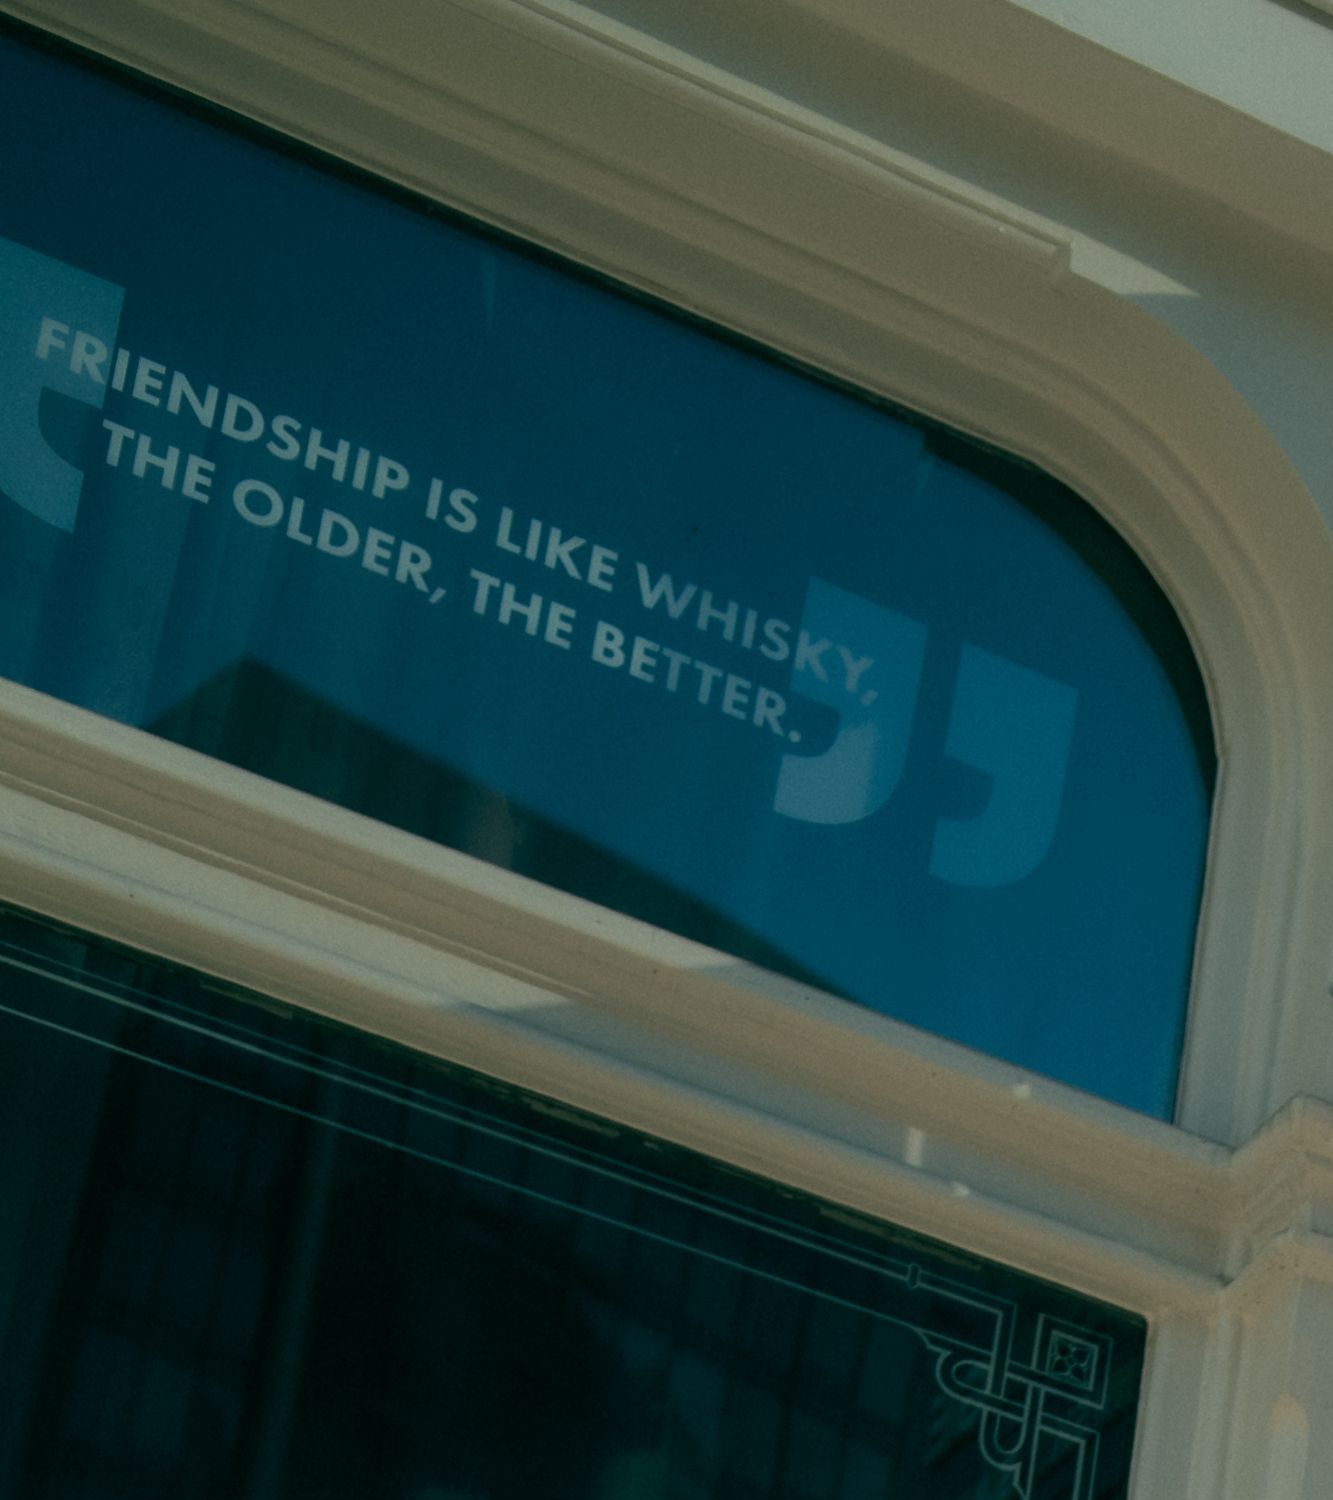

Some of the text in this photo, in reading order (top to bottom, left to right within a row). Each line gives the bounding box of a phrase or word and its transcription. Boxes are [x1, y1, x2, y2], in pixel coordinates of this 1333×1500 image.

[34, 317, 880, 704] FRIENDSHIP IS LIKE WHISKY,
[101, 420, 804, 743] THE OLDER, THE BETTER.
